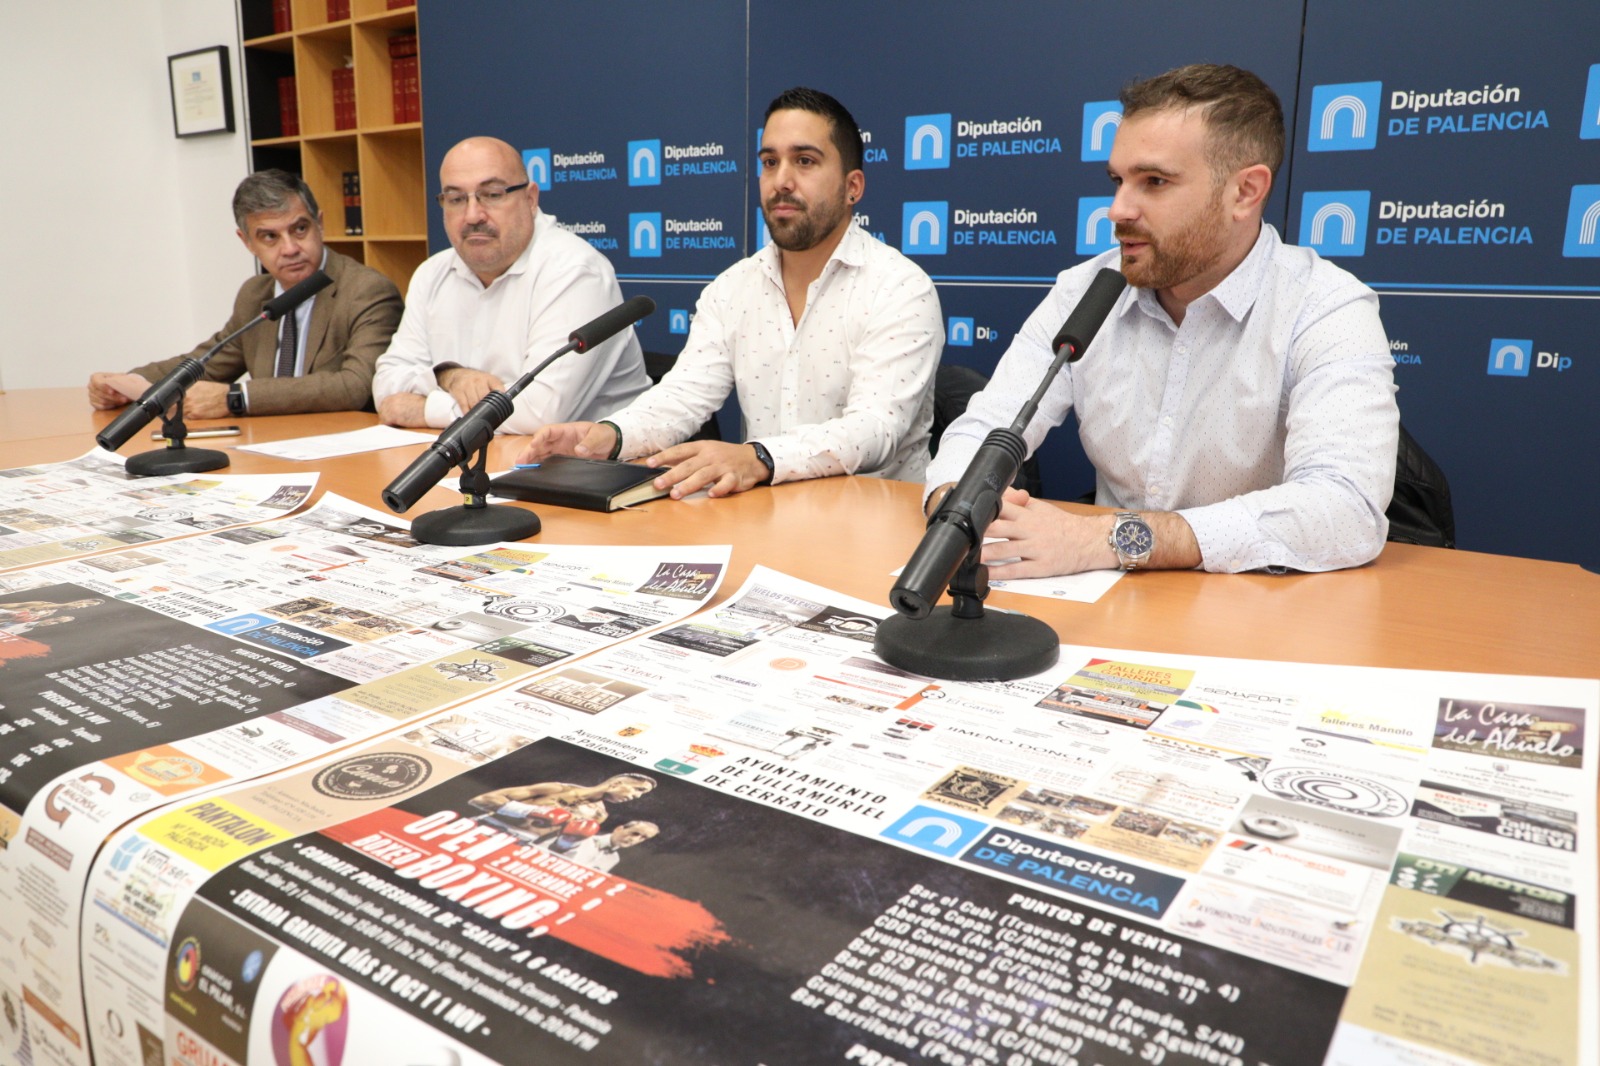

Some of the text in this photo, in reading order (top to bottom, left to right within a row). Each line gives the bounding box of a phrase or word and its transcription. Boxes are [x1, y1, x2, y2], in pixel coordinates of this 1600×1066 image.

[1391, 84, 1520, 112] Diputación
[957, 117, 1042, 138] Diputación
[1388, 110, 1549, 136] DE PALENCIA
[553, 151, 604, 168] Diputación
[665, 143, 723, 160] Diputación
[957, 138, 1062, 158] DE PALENCIA
[554, 168, 617, 182] DE PALENCIA
[665, 161, 737, 176] DE PALENCIA
[954, 208, 1038, 227] Diputación
[1379, 199, 1505, 223] Diputación
[665, 218, 723, 234] Diputación
[953, 230, 1057, 245] DE PALENCIA
[1376, 226, 1533, 245] DE PALENCIA
[666, 236, 736, 249] DE PALENCIA
[976, 326, 998, 342] Dip
[1536, 352, 1572, 372] Dip
[655, 563, 701, 581] La Casa
[260, 634, 321, 657] PALENCIA
[265, 625, 325, 647] Diputación
[1100, 669, 1171, 687] GARRIDO
[1108, 664, 1173, 680] TALLERES
[1320, 716, 1414, 738] Talleres Manolo
[1445, 700, 1535, 727] La Casa
[560, 734, 638, 762] de Palencia
[574, 729, 649, 756] Ayuntamiento
[947, 726, 1014, 745] JIMENO
[1018, 743, 1096, 764] DONCEL
[1441, 726, 1575, 757] del Abuelo
[720, 765, 888, 820] DE VILLAMURIEL
[736, 756, 888, 804] AYUNTAMIENTO
[702, 774, 831, 819] DE CERRATO
[184, 802, 277, 847] PANTALON
[403, 810, 517, 861] OPEN
[530, 850, 596, 884] OCTUBRE
[989, 832, 1136, 887] Diputación
[353, 833, 560, 929] BOXEO BOXING
[490, 856, 583, 899] 2 NOVIEMBRE
[973, 846, 1161, 915] DE PALENCIA
[350, 871, 441, 920] PROFESIONAL
[433, 912, 464, 928] DE
[510, 949, 532, 963] A
[526, 956, 548, 970] 6
[539, 963, 620, 1006] ASALTOS
[1008, 893, 1085, 927] PUNTOS
[1087, 917, 1118, 936] DE
[1120, 926, 1183, 958] VENTA
[884, 904, 1113, 992] Aberdeen 39)
[897, 894, 919, 909] As
[920, 902, 942, 917] de
[943, 908, 994, 936] Copas
[1076, 954, 1101, 972] de
[1177, 985, 1199, 1006] 1)
[908, 884, 939, 901] Bar
[939, 895, 960, 907] el
[1080, 939, 1105, 957] de
[1106, 947, 1127, 965] la
[1216, 983, 1241, 1004] 4)
[233, 888, 488, 1034] ENTRADA GRATUITA DÍAS 31 OCT Y 1 NOV
[820, 961, 899, 1003] Gimnasio
[859, 925, 1149, 1040] Ayuntamiento de Villamuriel (Av.
[874, 914, 912, 936] CDO
[911, 927, 988, 965] Covaresa
[1076, 984, 1114, 1008] San
[1194, 1023, 1246, 1056] S/N)
[834, 949, 1084, 1056] Bar Olimpia (Av. San Telmo)
[847, 936, 1167, 1066] Bar 979 (Av. Derechos 3)
[857, 995, 917, 1027] Brasil
[789, 986, 921, 1050] Bar Barriloche
